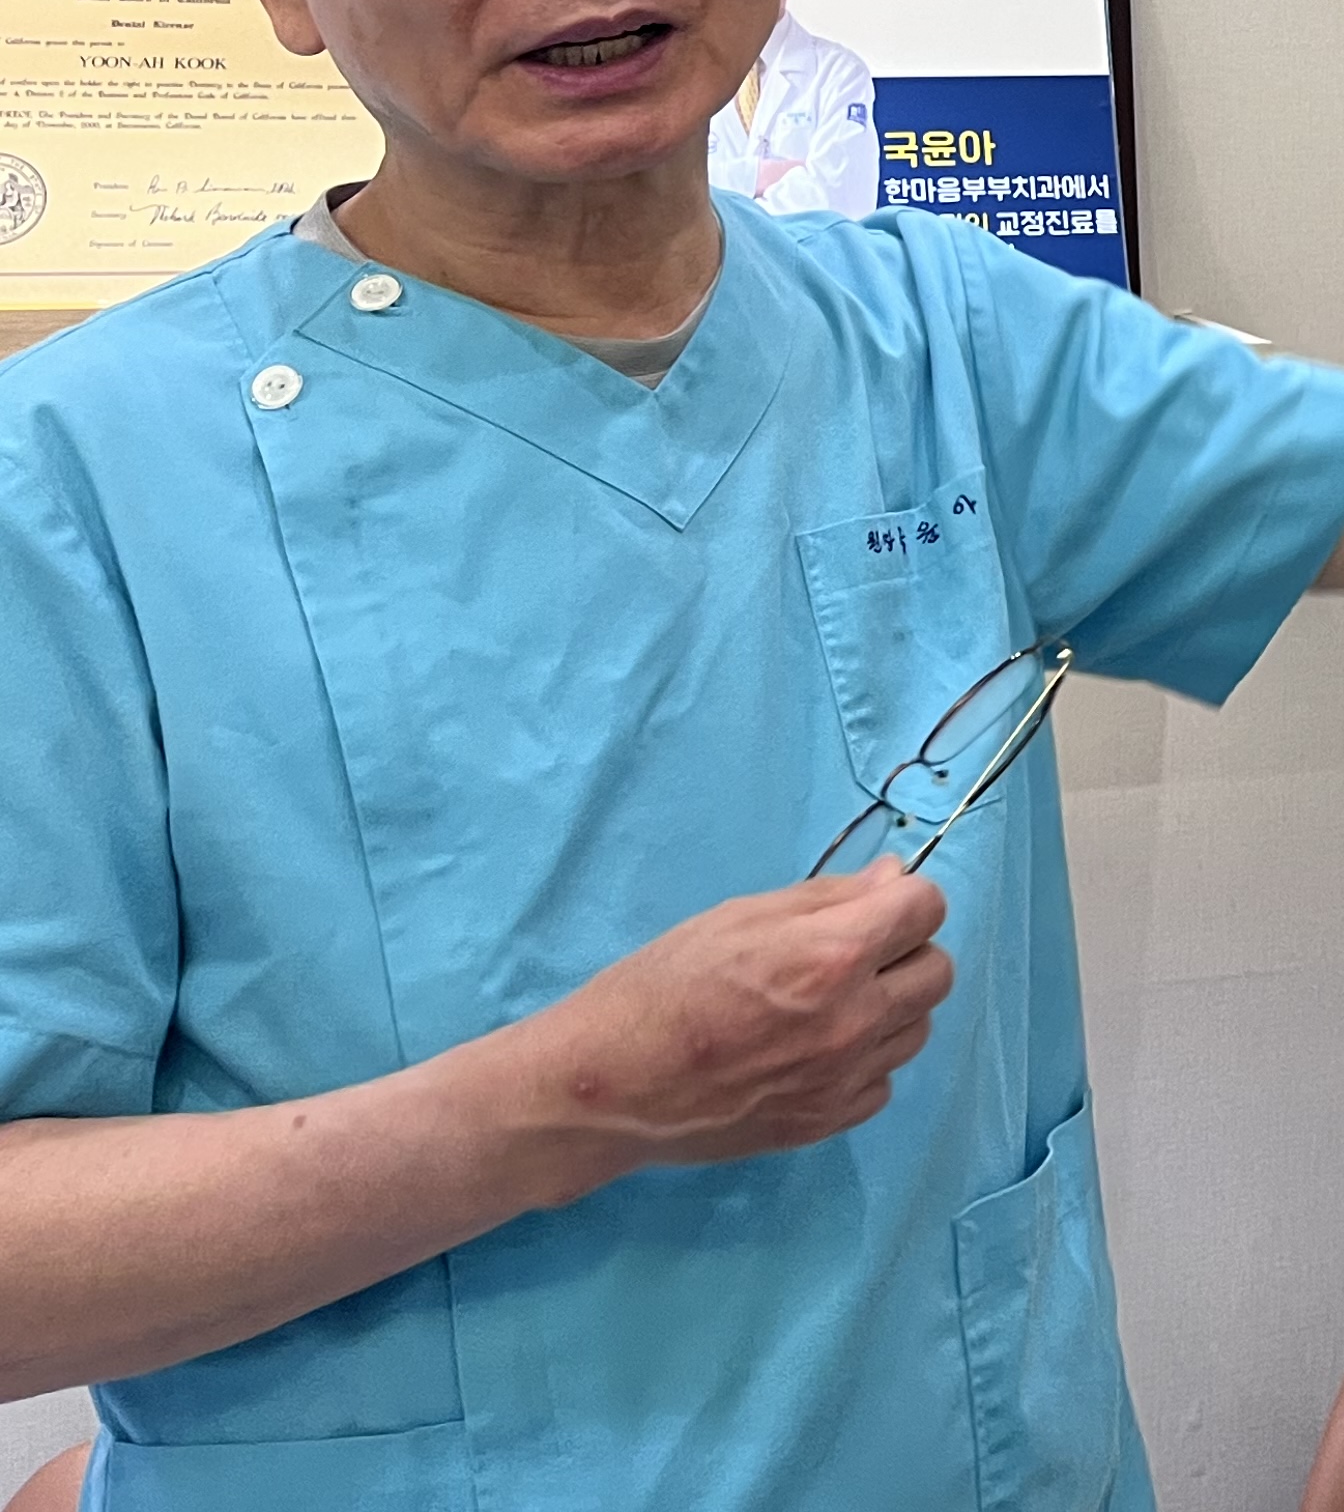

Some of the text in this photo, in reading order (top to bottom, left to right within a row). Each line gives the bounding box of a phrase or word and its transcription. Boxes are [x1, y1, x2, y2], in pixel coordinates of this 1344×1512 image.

[79, 55, 228, 70] YOON-AH KOOK
[883, 130, 996, 168] 국윤아
[884, 174, 1109, 204] 한마음부부치과에서
[996, 209, 1118, 236] 교정진료를
